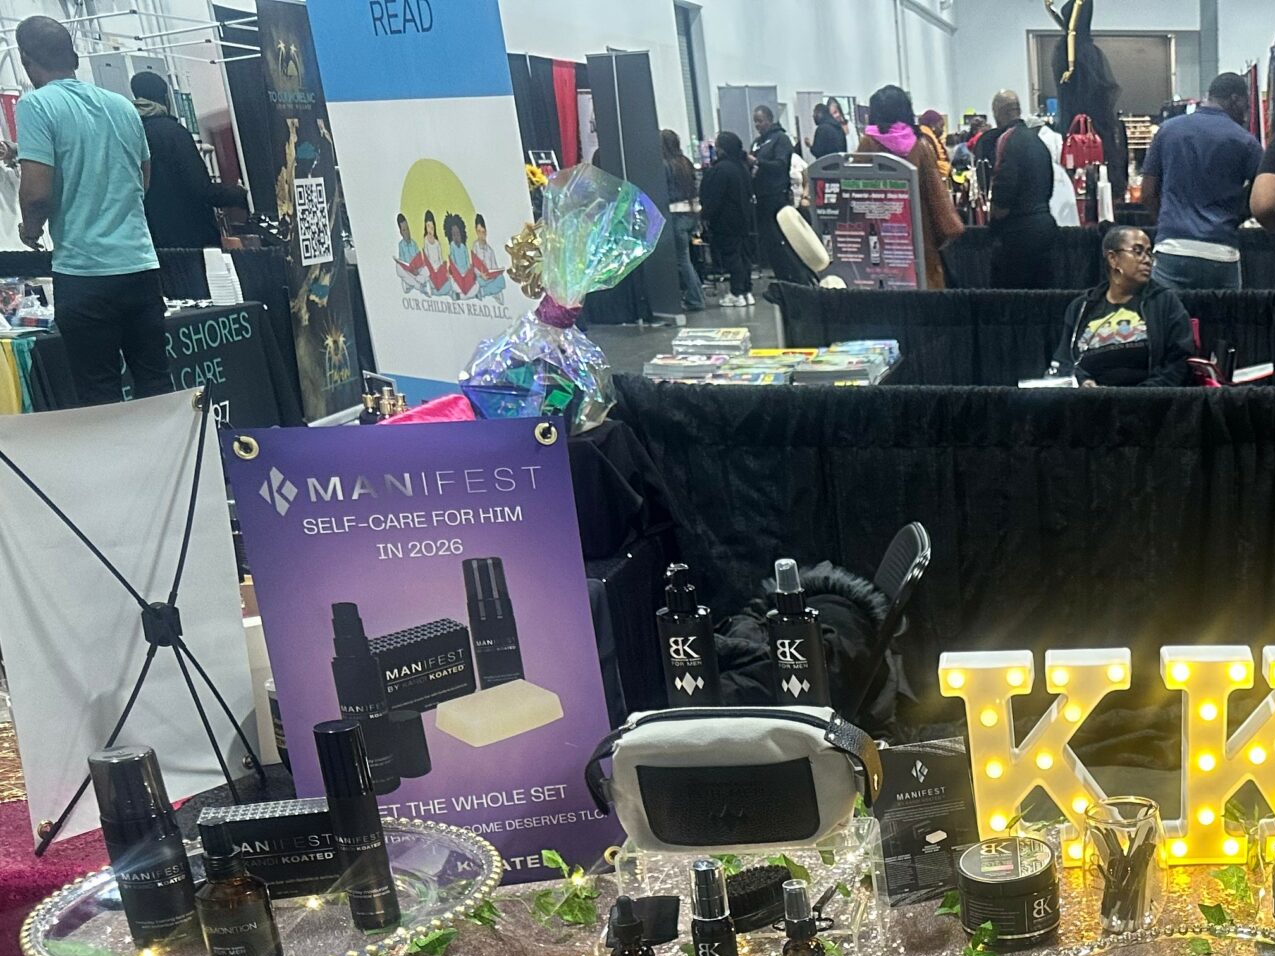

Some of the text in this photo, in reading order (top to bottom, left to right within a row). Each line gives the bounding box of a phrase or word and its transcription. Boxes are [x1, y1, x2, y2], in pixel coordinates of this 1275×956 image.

[369, 0, 433, 36] READ
[402, 297, 422, 310] OUR
[422, 300, 465, 315] CHILDREN
[179, 311, 252, 355] SHORES
[181, 357, 227, 390] CARE
[306, 465, 542, 502] MANIFEST
[303, 506, 523, 535] SELF-CARE FOR HIM
[376, 539, 464, 560] IN 2026
[386, 649, 464, 681] MANIFEST
[429, 664, 465, 681] KOATED
[378, 784, 568, 819] ET THE WHOLE SET
[896, 786, 946, 801] MANIFEST
[506, 811, 577, 831] DESERVES
[281, 851, 336, 864] KOATED
